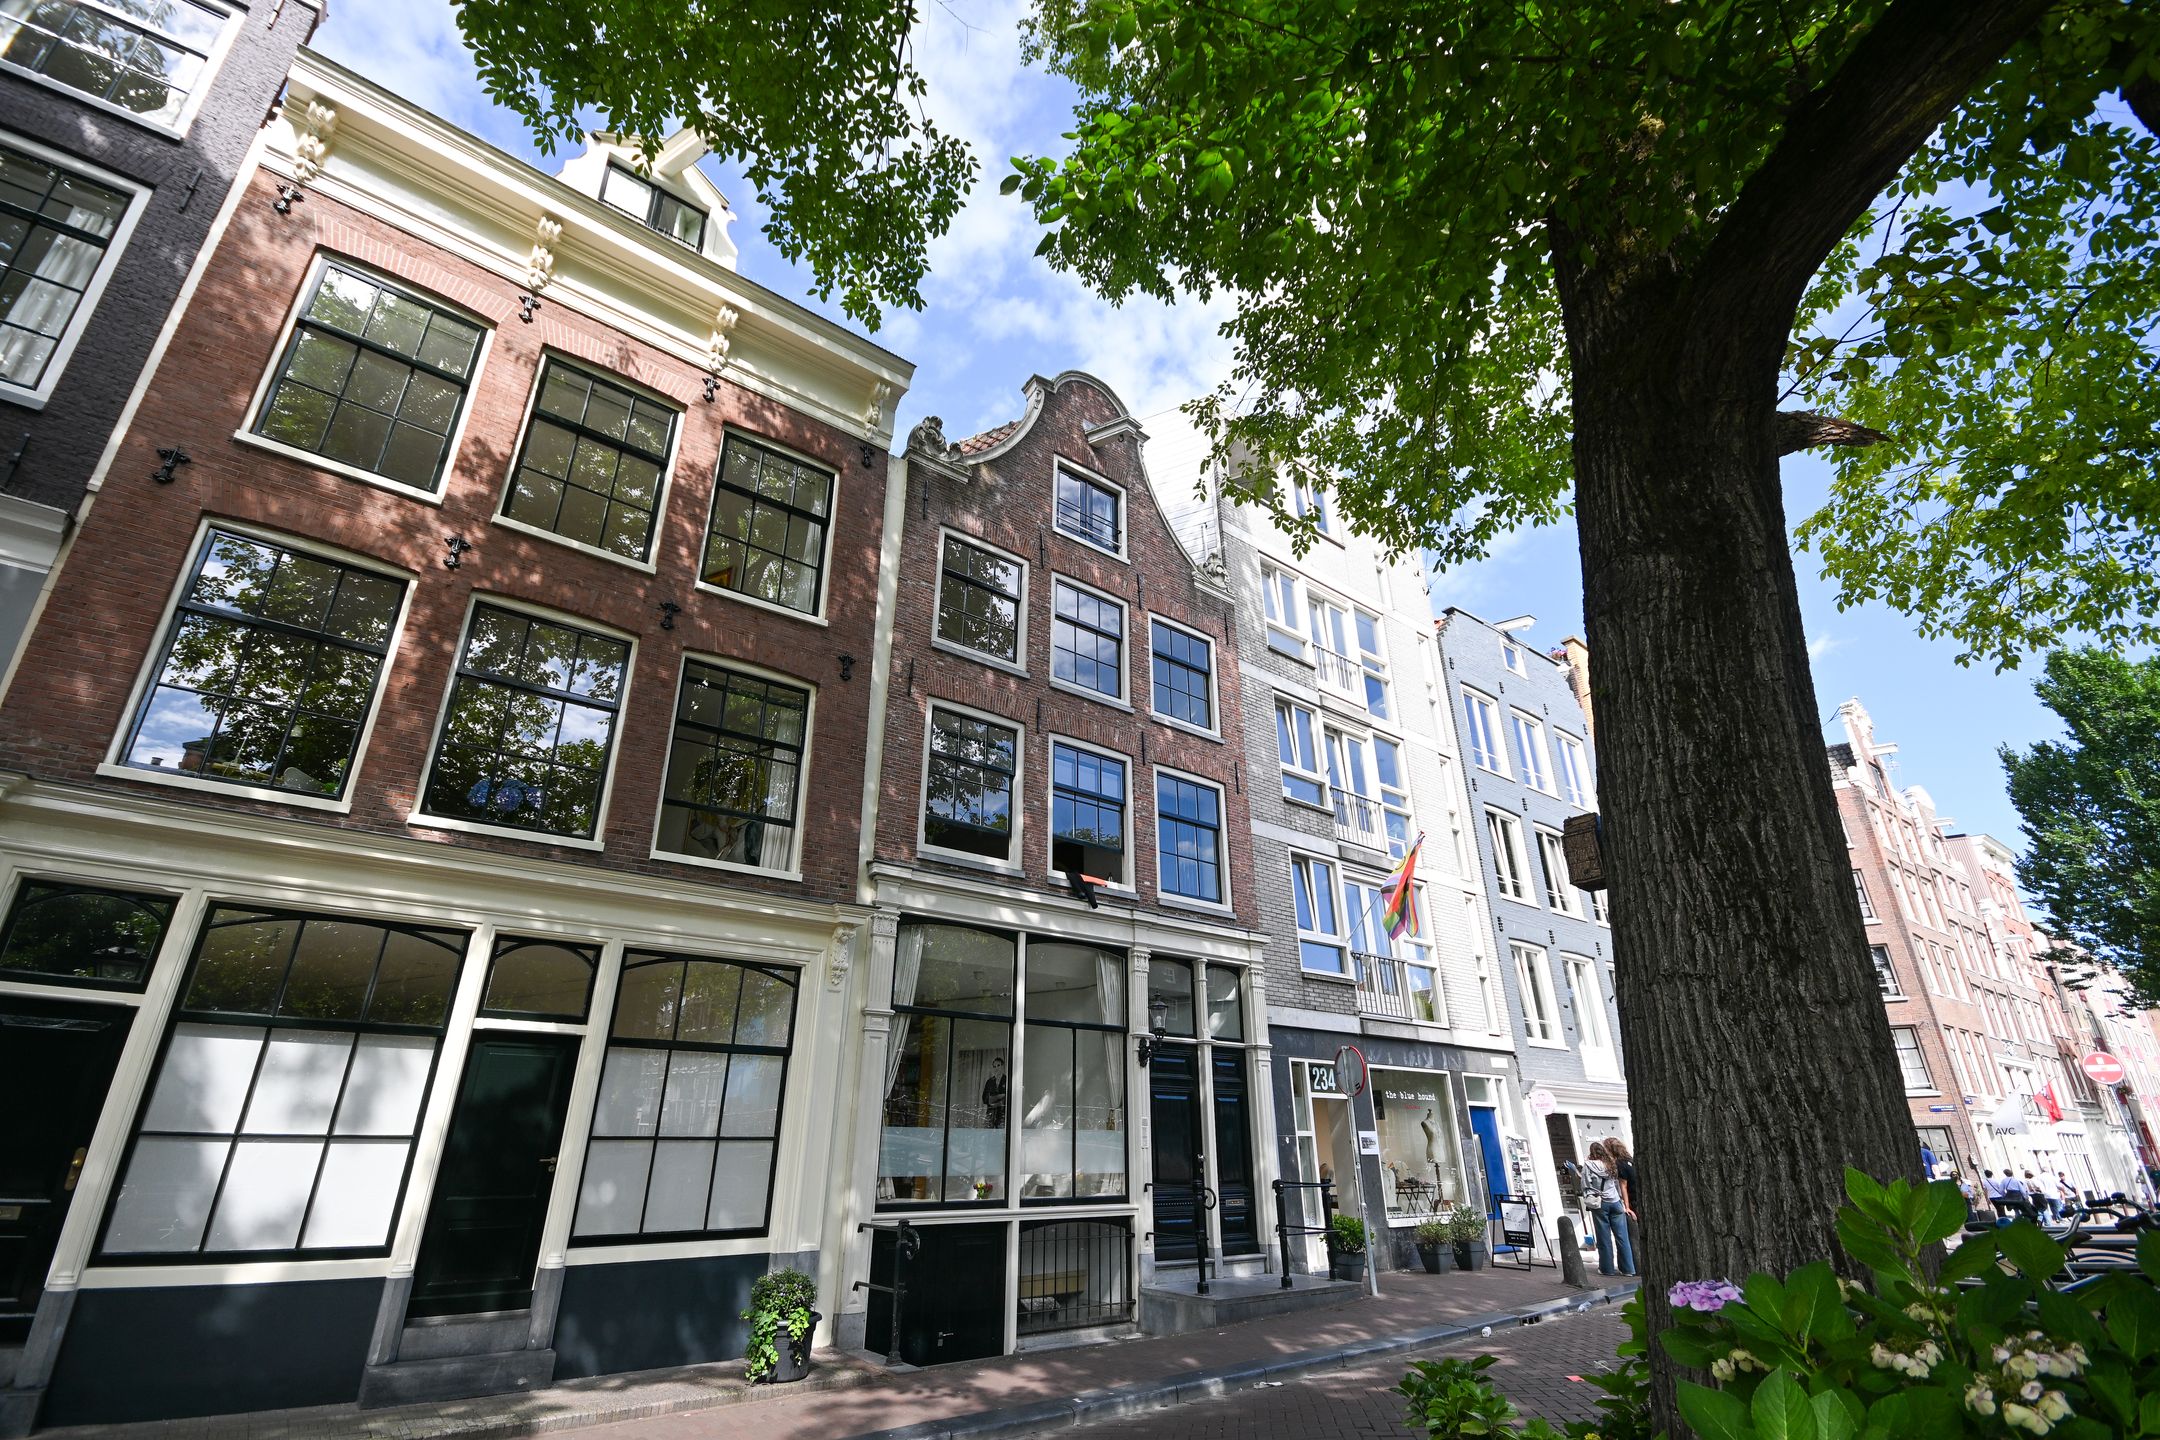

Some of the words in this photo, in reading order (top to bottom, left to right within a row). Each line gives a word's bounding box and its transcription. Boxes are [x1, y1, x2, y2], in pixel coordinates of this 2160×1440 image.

[1312, 1066, 1336, 1091] 234
[1385, 1090, 1397, 1099] the
[1399, 1091, 1415, 1100] blue
[1417, 1092, 1436, 1101] hound
[1995, 1127, 2016, 1136] AVC
